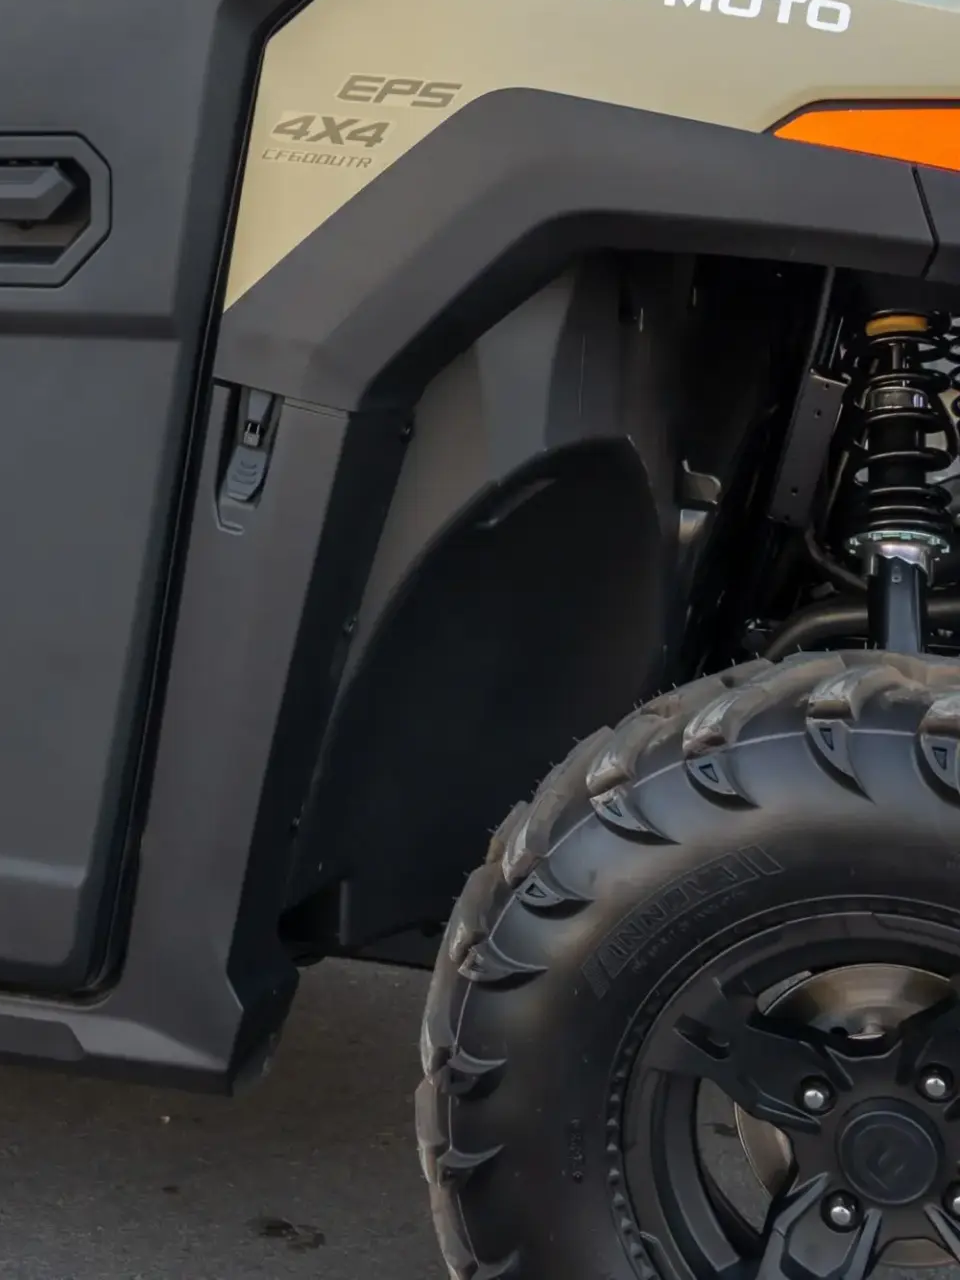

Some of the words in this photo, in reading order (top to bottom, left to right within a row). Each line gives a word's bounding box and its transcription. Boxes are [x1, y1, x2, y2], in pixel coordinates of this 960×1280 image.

[336, 74, 462, 108] EPS
[272, 115, 390, 148] 4X4
[261, 148, 373, 169] CF600UTR
